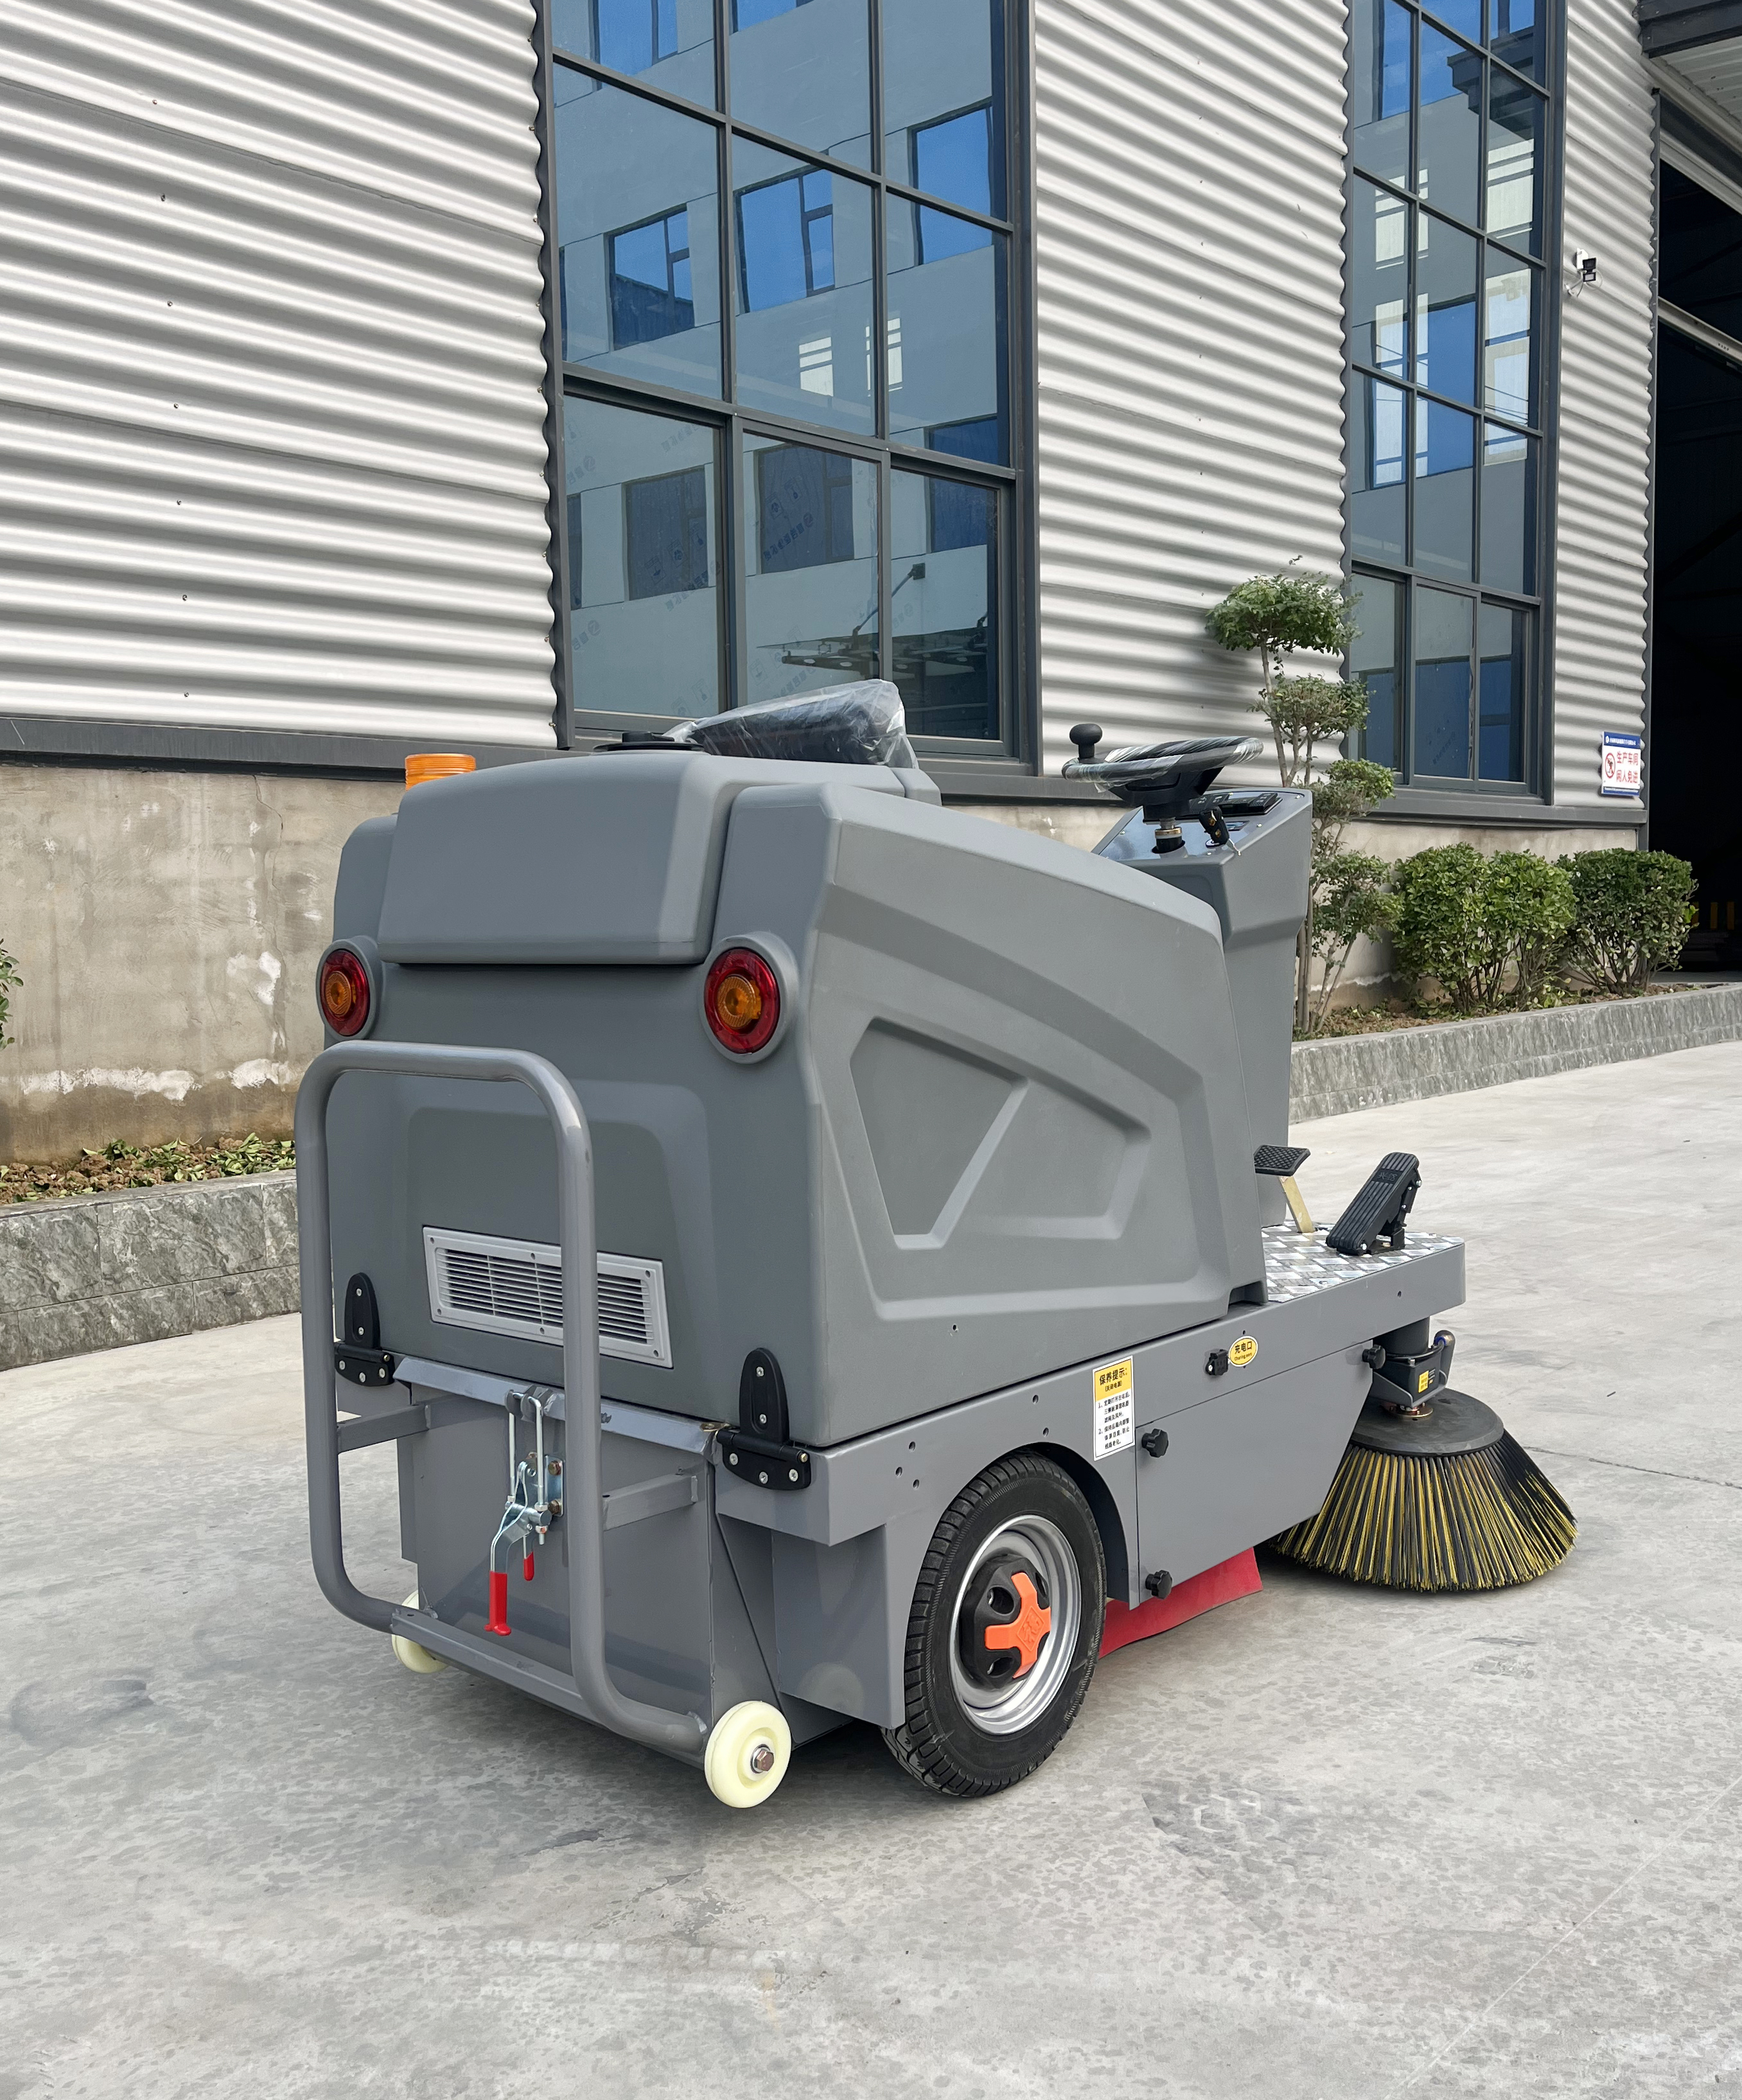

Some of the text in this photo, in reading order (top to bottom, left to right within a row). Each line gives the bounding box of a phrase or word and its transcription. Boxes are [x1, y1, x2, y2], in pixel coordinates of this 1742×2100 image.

[1617, 751, 1639, 766] 生产车间
[1617, 769, 1638, 783] 闲人免进
[1235, 1341, 1252, 1354] 充电口
